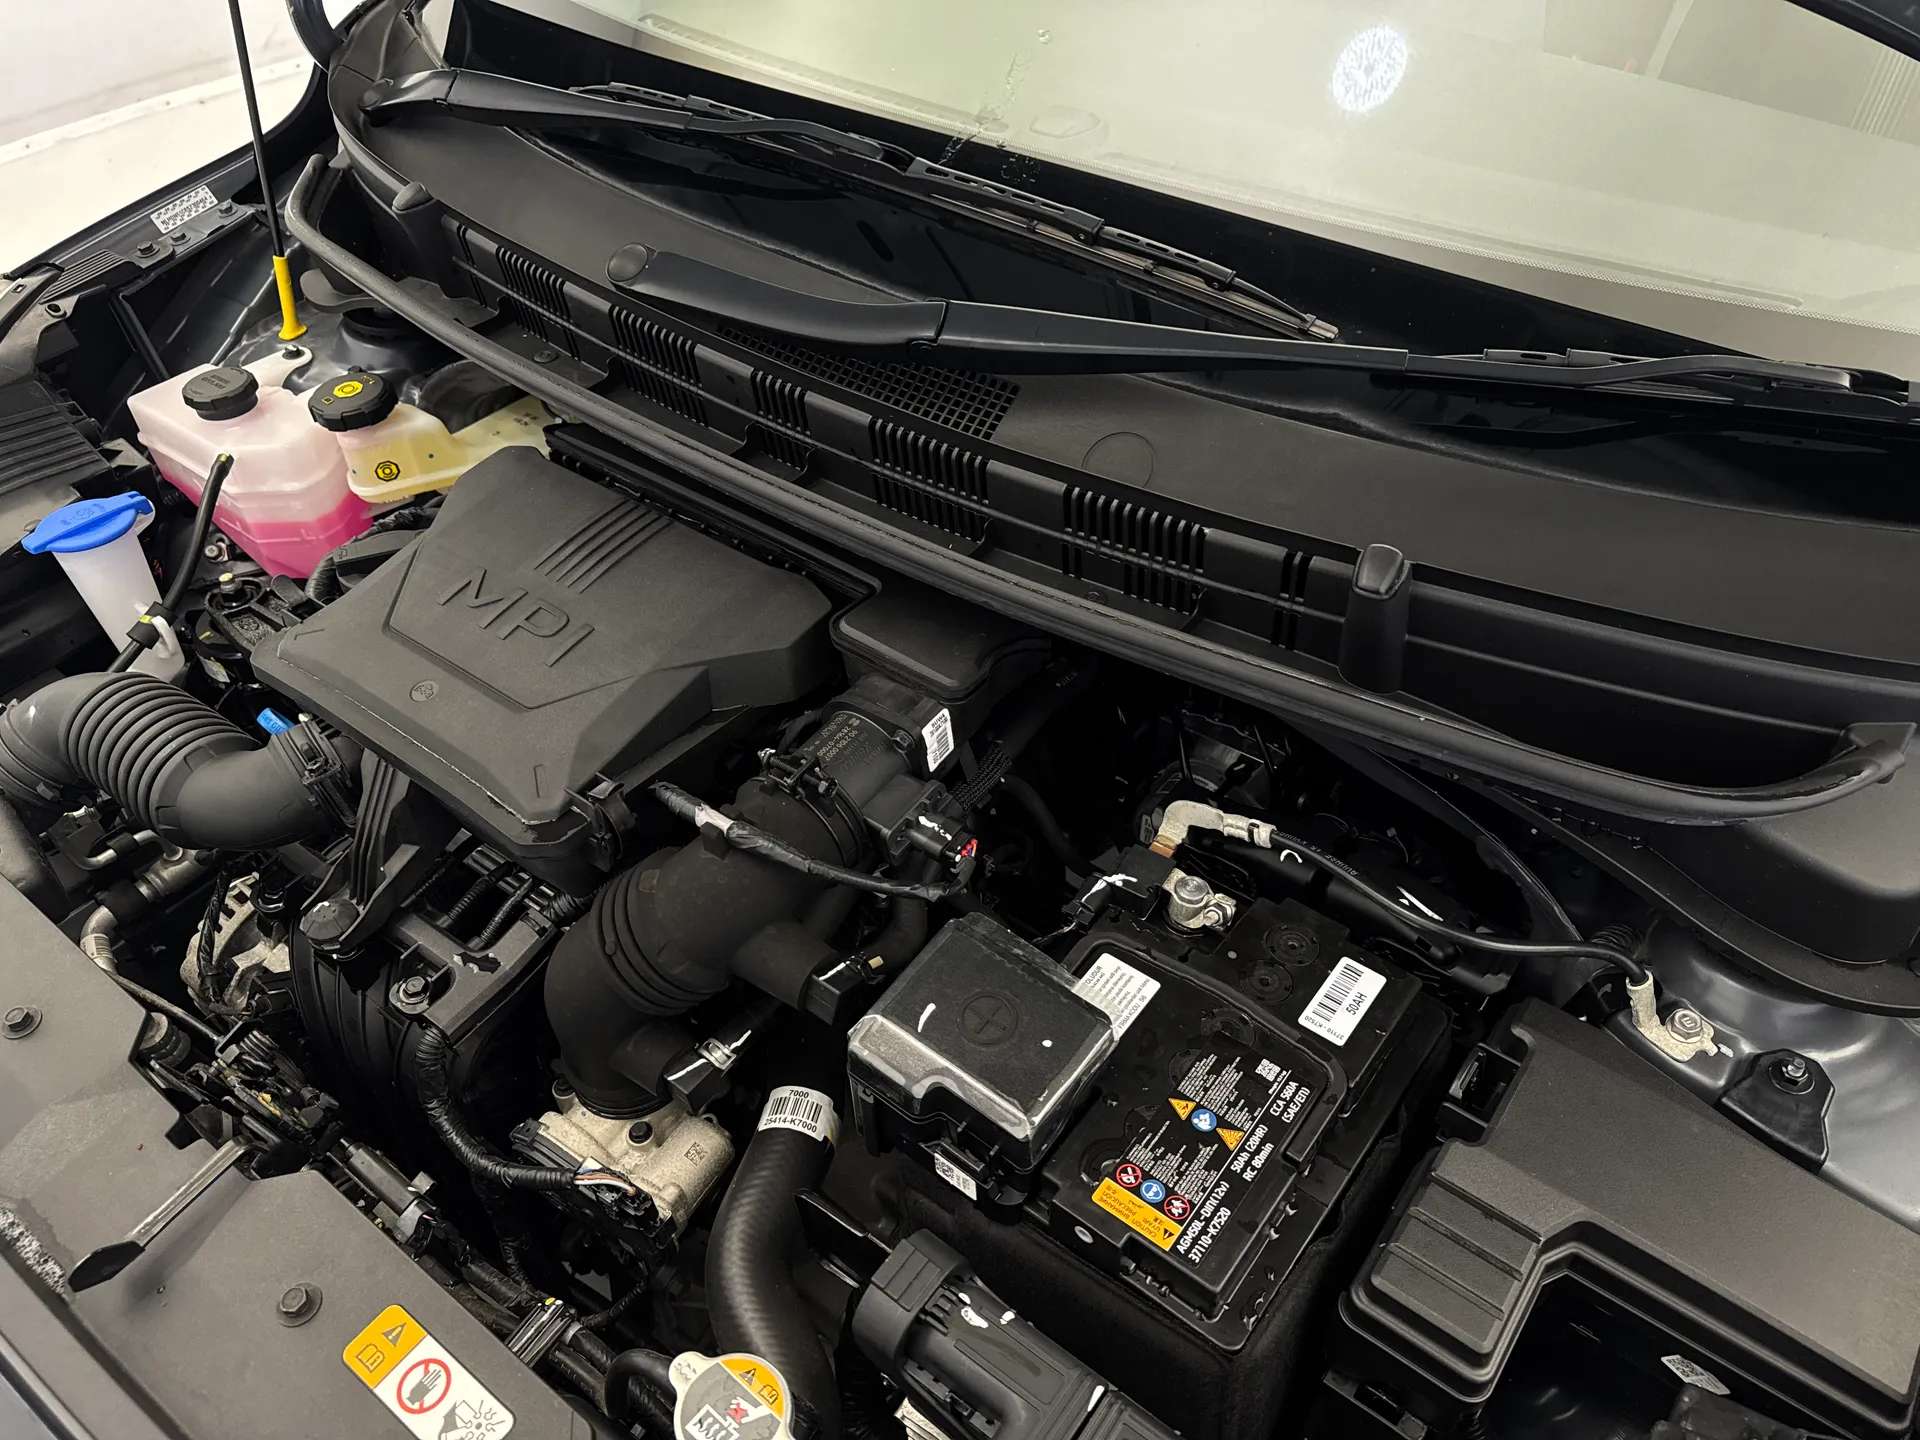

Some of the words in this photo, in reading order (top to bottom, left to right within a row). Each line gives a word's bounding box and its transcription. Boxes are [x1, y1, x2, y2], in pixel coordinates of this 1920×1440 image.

[435, 567, 594, 666] MPI
[1346, 992, 1367, 1015] 50AH
[1681, 1017, 1695, 1027] E
[788, 1089, 809, 1098] 7000
[764, 1116, 817, 1132] 25414-K7000
[1230, 1150, 1250, 1173] 50Ah
[1243, 1123, 1268, 1153] (20HR)
[1269, 1097, 1286, 1117] CCA
[1279, 1079, 1299, 1101] 560A
[1187, 1206, 1231, 1263] 37110-K7520
[1242, 1166, 1257, 1182] RC
[1250, 1141, 1274, 1169] 80min
